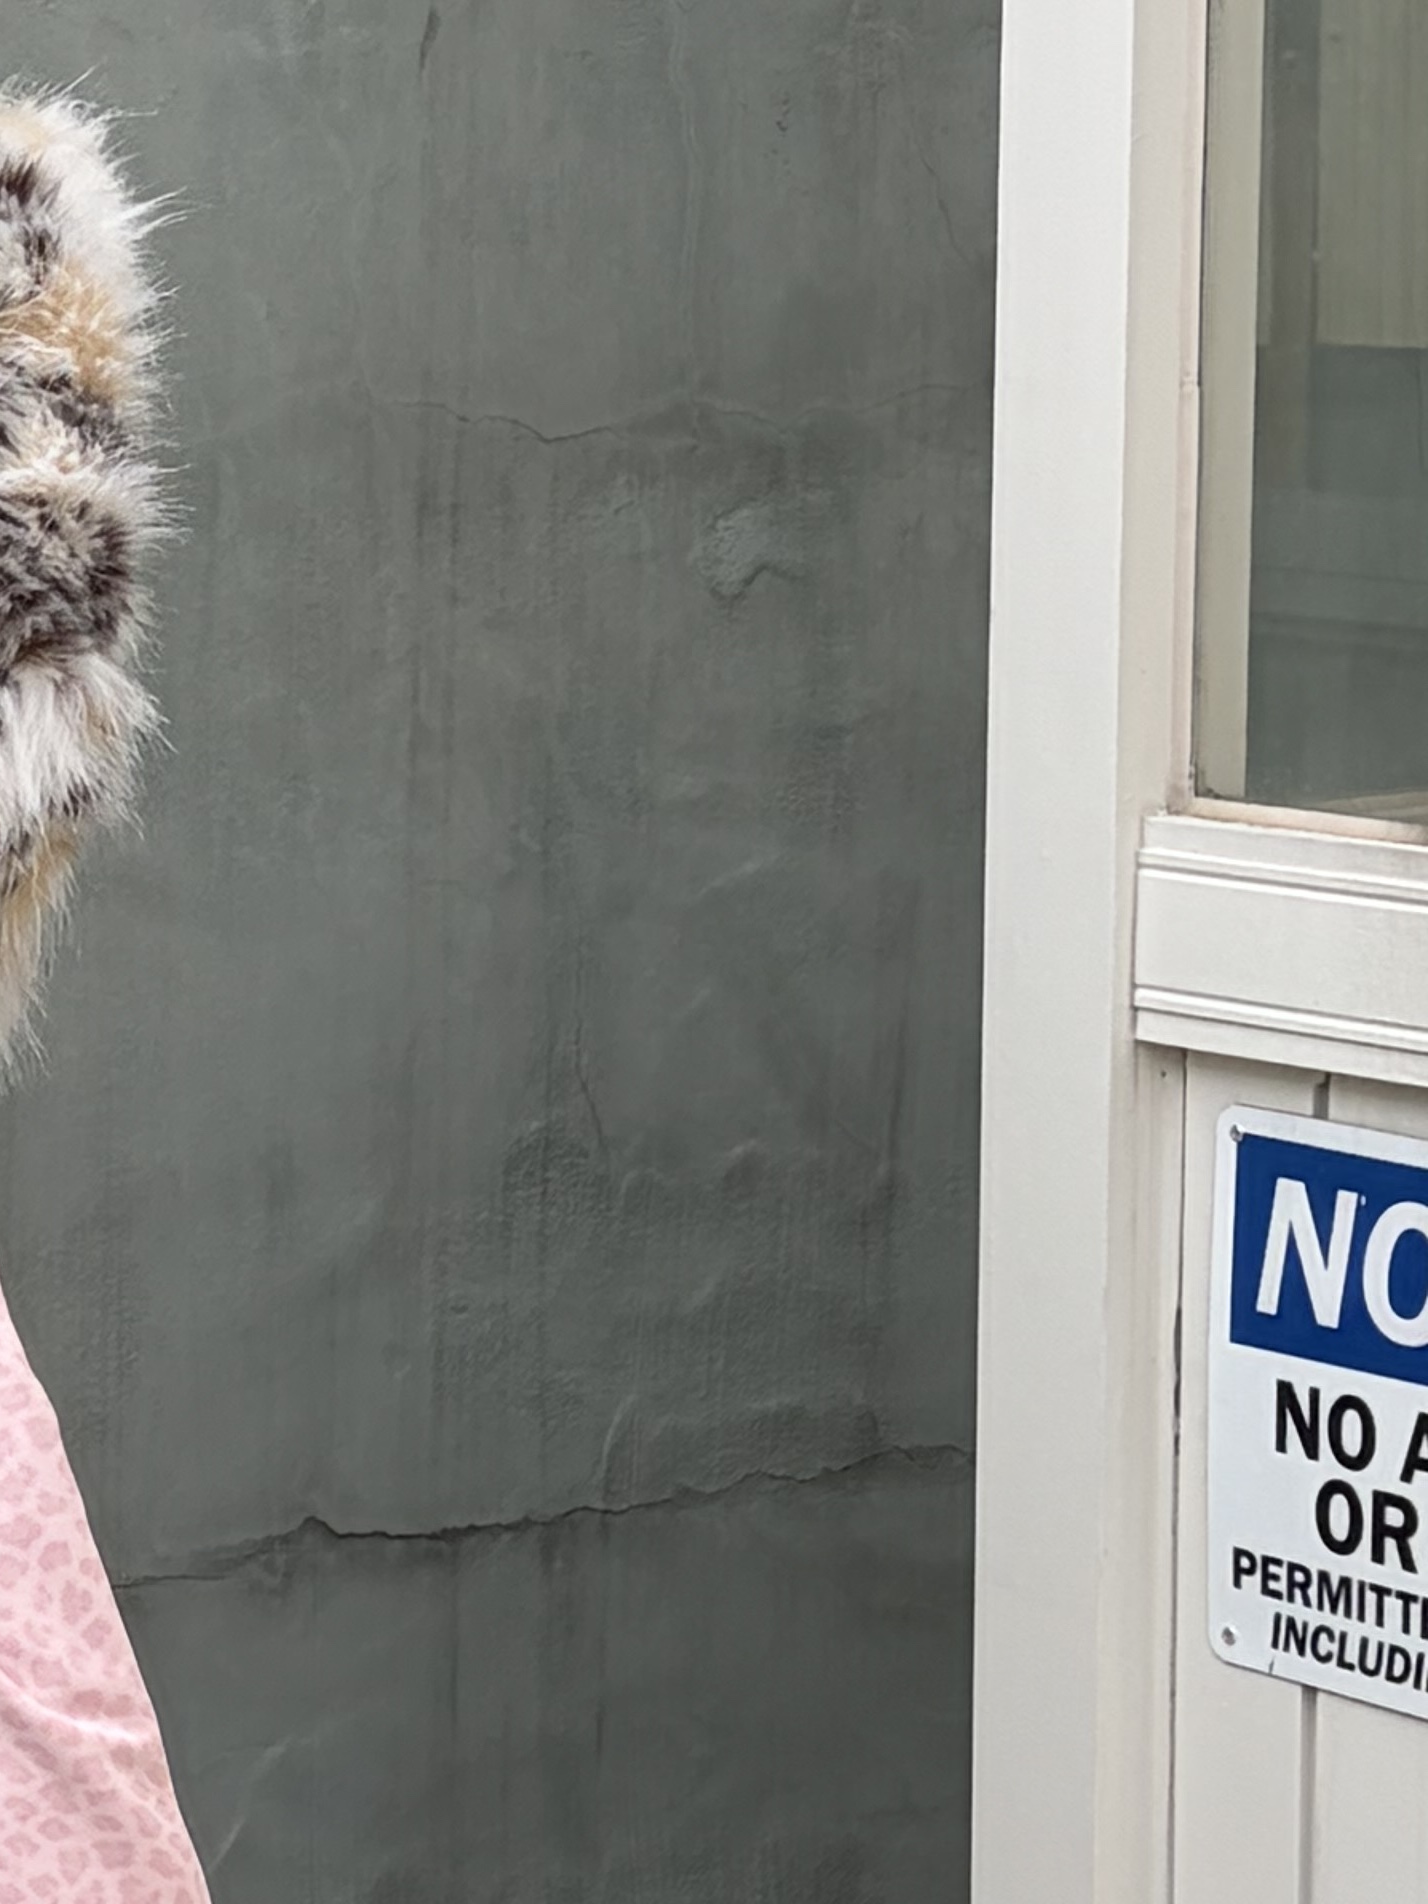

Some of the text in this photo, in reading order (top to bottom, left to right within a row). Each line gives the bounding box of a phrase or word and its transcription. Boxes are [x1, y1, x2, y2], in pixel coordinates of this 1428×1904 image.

[1276, 1378, 1376, 1472] NO
[1315, 1478, 1418, 1574] OR
[1271, 1611, 1428, 1693] INCLUDI
